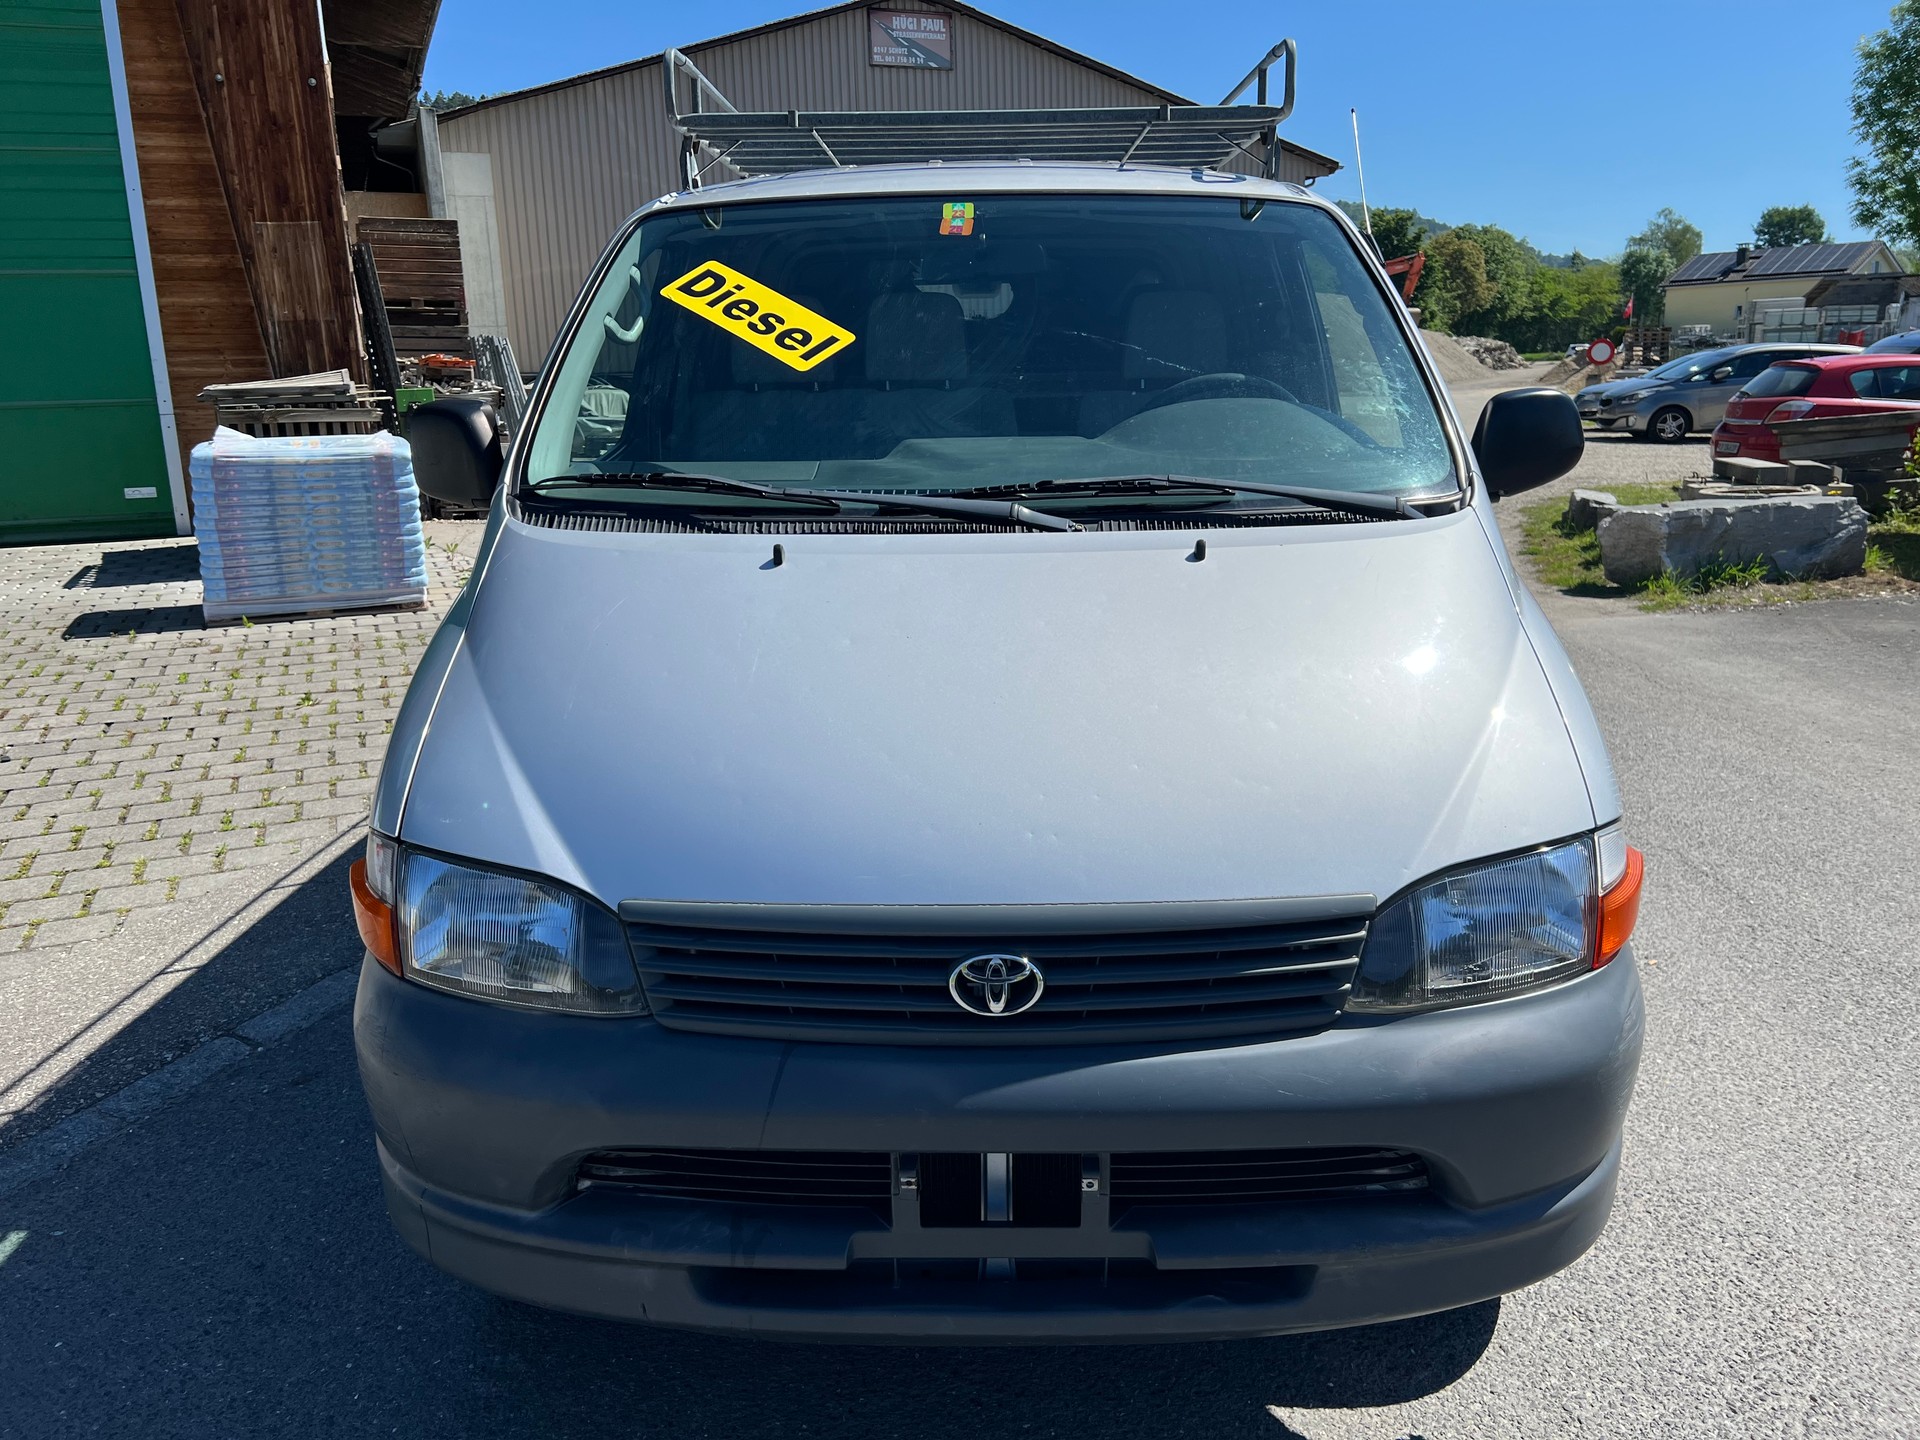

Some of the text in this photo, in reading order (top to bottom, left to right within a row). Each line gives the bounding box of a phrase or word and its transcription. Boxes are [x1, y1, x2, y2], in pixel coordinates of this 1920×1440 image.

[892, 15, 945, 31] HÜGI PAUL
[676, 268, 840, 362] Diesel
